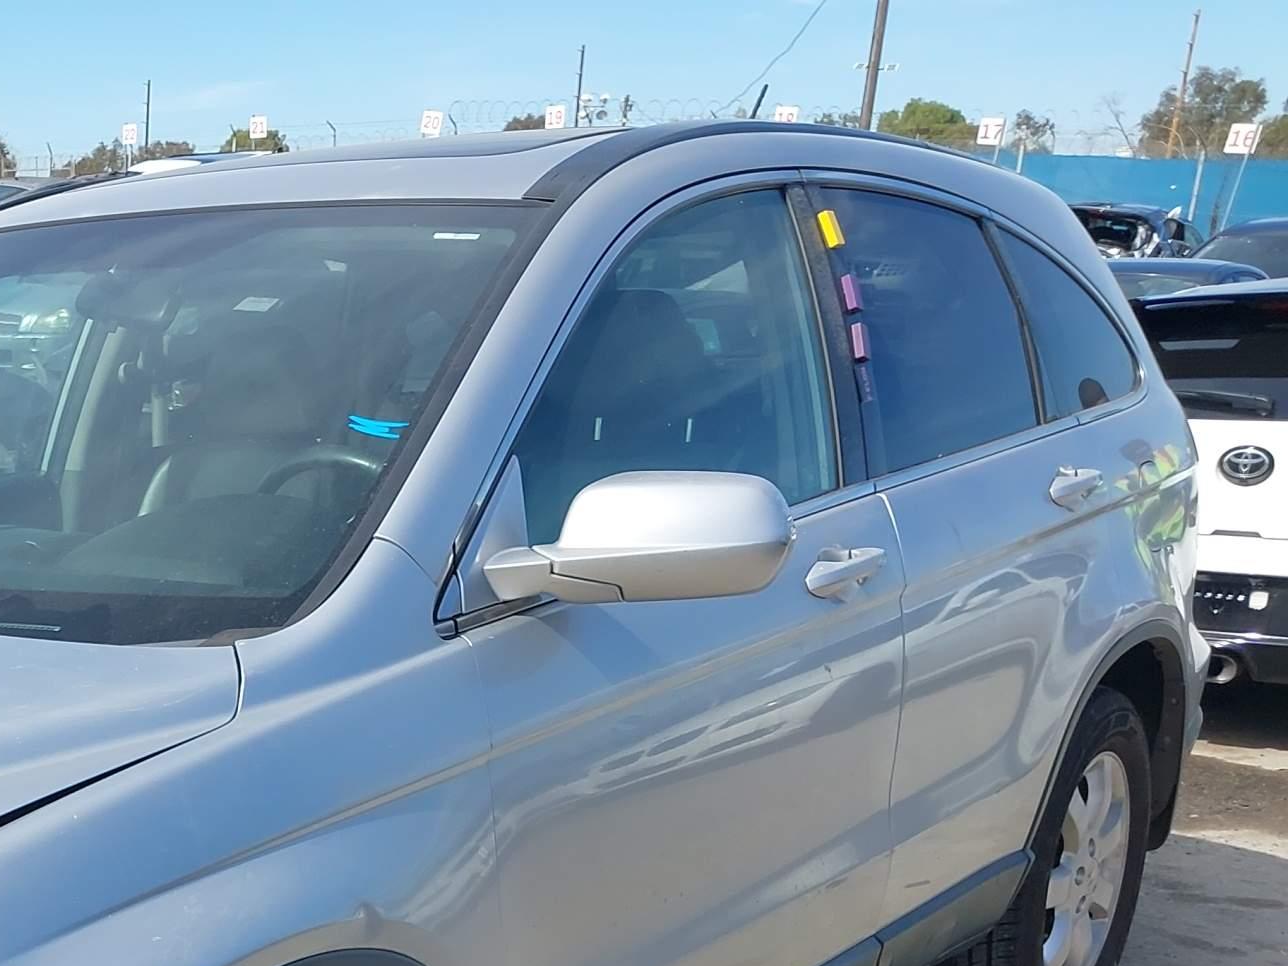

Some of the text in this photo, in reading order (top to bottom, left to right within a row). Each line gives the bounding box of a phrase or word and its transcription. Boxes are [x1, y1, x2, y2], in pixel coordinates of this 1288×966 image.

[423, 115, 440, 130] 20
[547, 110, 563, 125] 19
[251, 121, 265, 134] 21
[979, 123, 1003, 140] 17
[1228, 130, 1256, 148] 16
